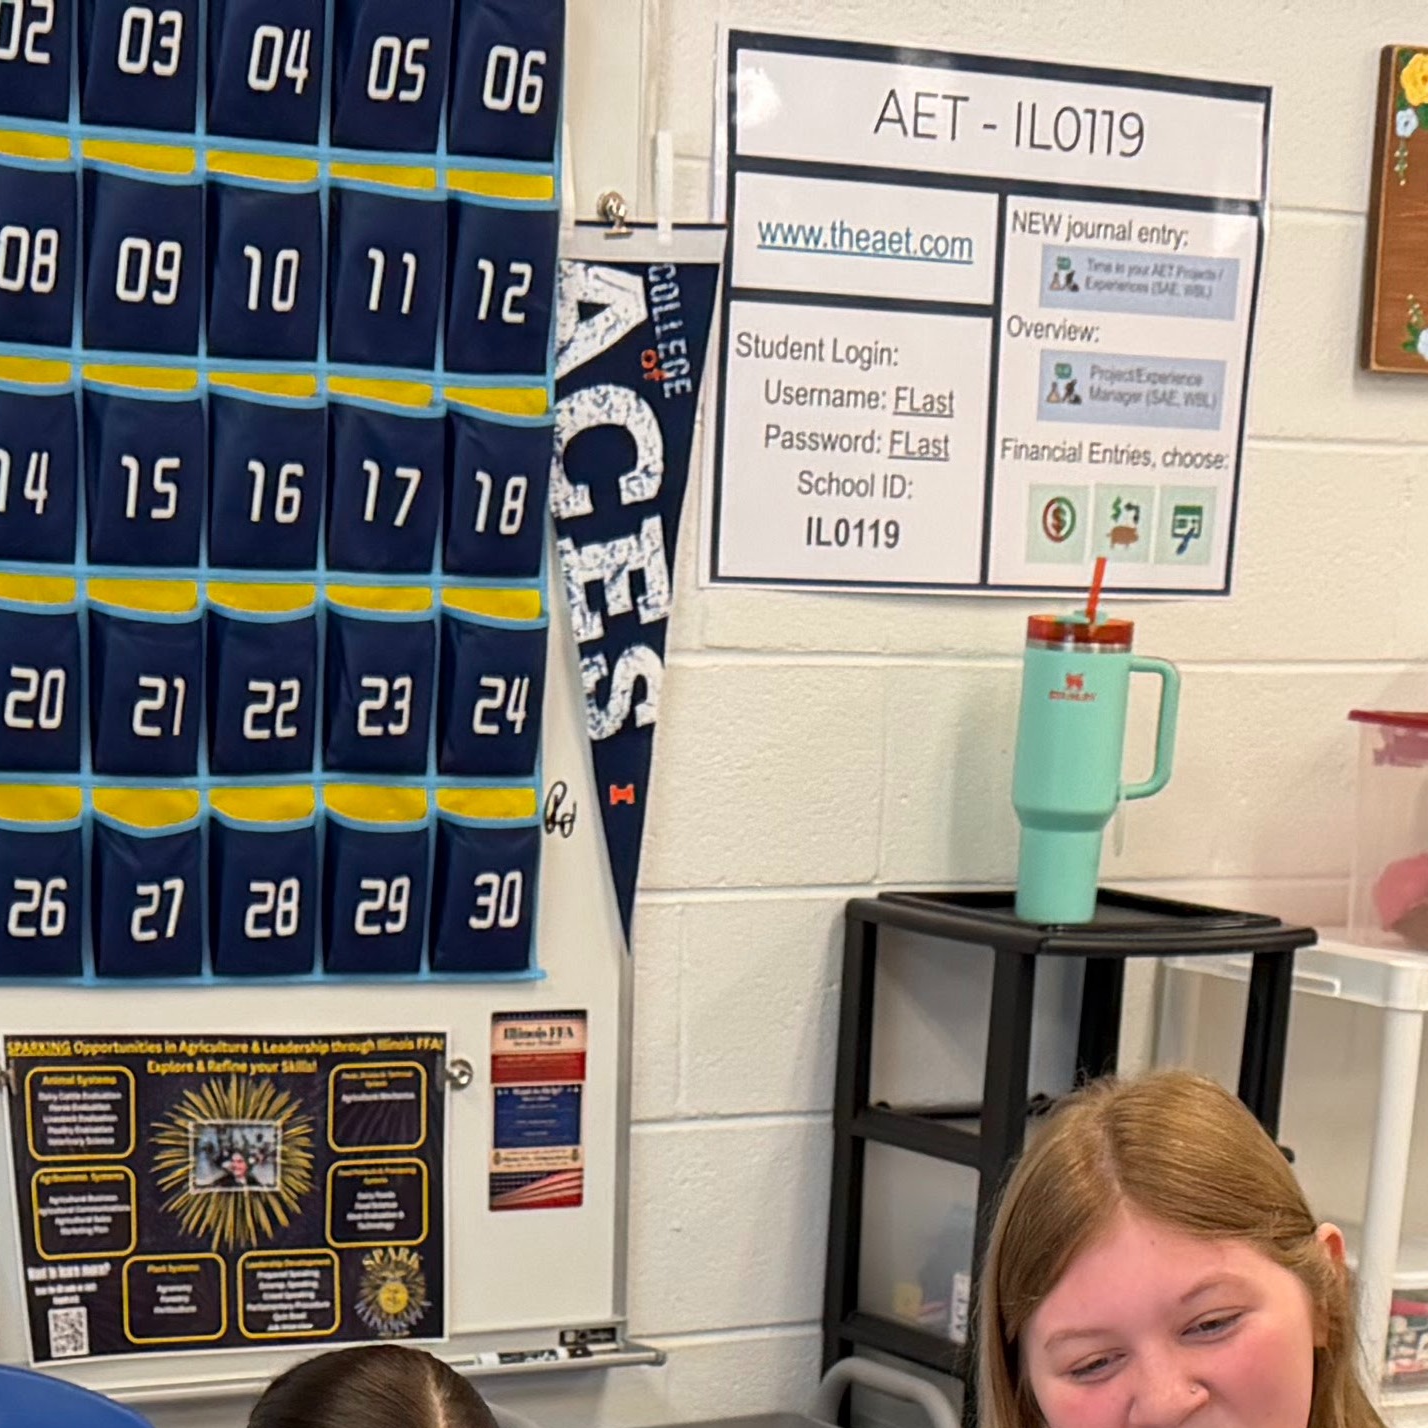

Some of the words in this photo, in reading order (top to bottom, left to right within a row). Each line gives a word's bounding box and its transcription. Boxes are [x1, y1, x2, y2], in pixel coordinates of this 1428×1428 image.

[117, 6, 183, 76] 03
[247, 25, 311, 94] 04
[367, 36, 430, 102] 05
[482, 45, 547, 114] 06
[874, 88, 969, 141] AET
[1013, 100, 1146, 157] IL0119
[757, 218, 974, 262] www.theaet.com
[1011, 211, 1062, 236] NEW
[1065, 217, 1134, 246] journal
[1137, 223, 1190, 250] entry:
[115, 237, 182, 305] 09
[243, 245, 299, 312] 10
[368, 247, 416, 314] 11
[477, 258, 532, 323] 12
[1086, 257, 1112, 272] Time
[1127, 263, 1151, 278] your
[1152, 262, 1174, 277] AET
[648, 262, 693, 398] COLLEGE
[1006, 313, 1101, 343] Overview:
[735, 331, 825, 362] Student
[830, 338, 900, 367] Login:
[763, 378, 889, 411] Username:
[892, 386, 955, 416] FLast
[1089, 385, 1143, 407] Manager
[762, 424, 884, 457] Password:
[887, 431, 951, 460] FLast
[1001, 437, 1083, 461] Financial
[1088, 441, 1157, 469] Entries,
[1160, 446, 1230, 470] choose:
[121, 455, 181, 519] 15
[247, 460, 304, 523] 16
[362, 459, 421, 527] 17
[475, 470, 528, 535] 18
[551, 259, 667, 741] ACES
[797, 469, 878, 500] School
[881, 473, 913, 501] ID:
[805, 514, 902, 550] IL0119
[4, 666, 66, 729] 20
[132, 675, 185, 737] 21
[243, 679, 300, 739] 22
[357, 676, 412, 736] 23
[472, 676, 530, 735] 24
[7, 877, 67, 937] 26
[130, 878, 184, 941] 27
[244, 877, 300, 938] 28
[354, 876, 411, 935] 29
[468, 870, 523, 929] 30
[73, 1040, 162, 1057] Opportunities
[165, 1041, 177, 1053] in
[179, 1040, 249, 1056] Agriculture
[263, 1040, 330, 1056] Leadership
[331, 1038, 376, 1056] through
[503, 1026, 548, 1041] Illinois
[549, 1025, 575, 1040] FFA
[147, 1059, 194, 1076] Explore
[208, 1059, 248, 1074] Refine
[250, 1061, 279, 1077] your
